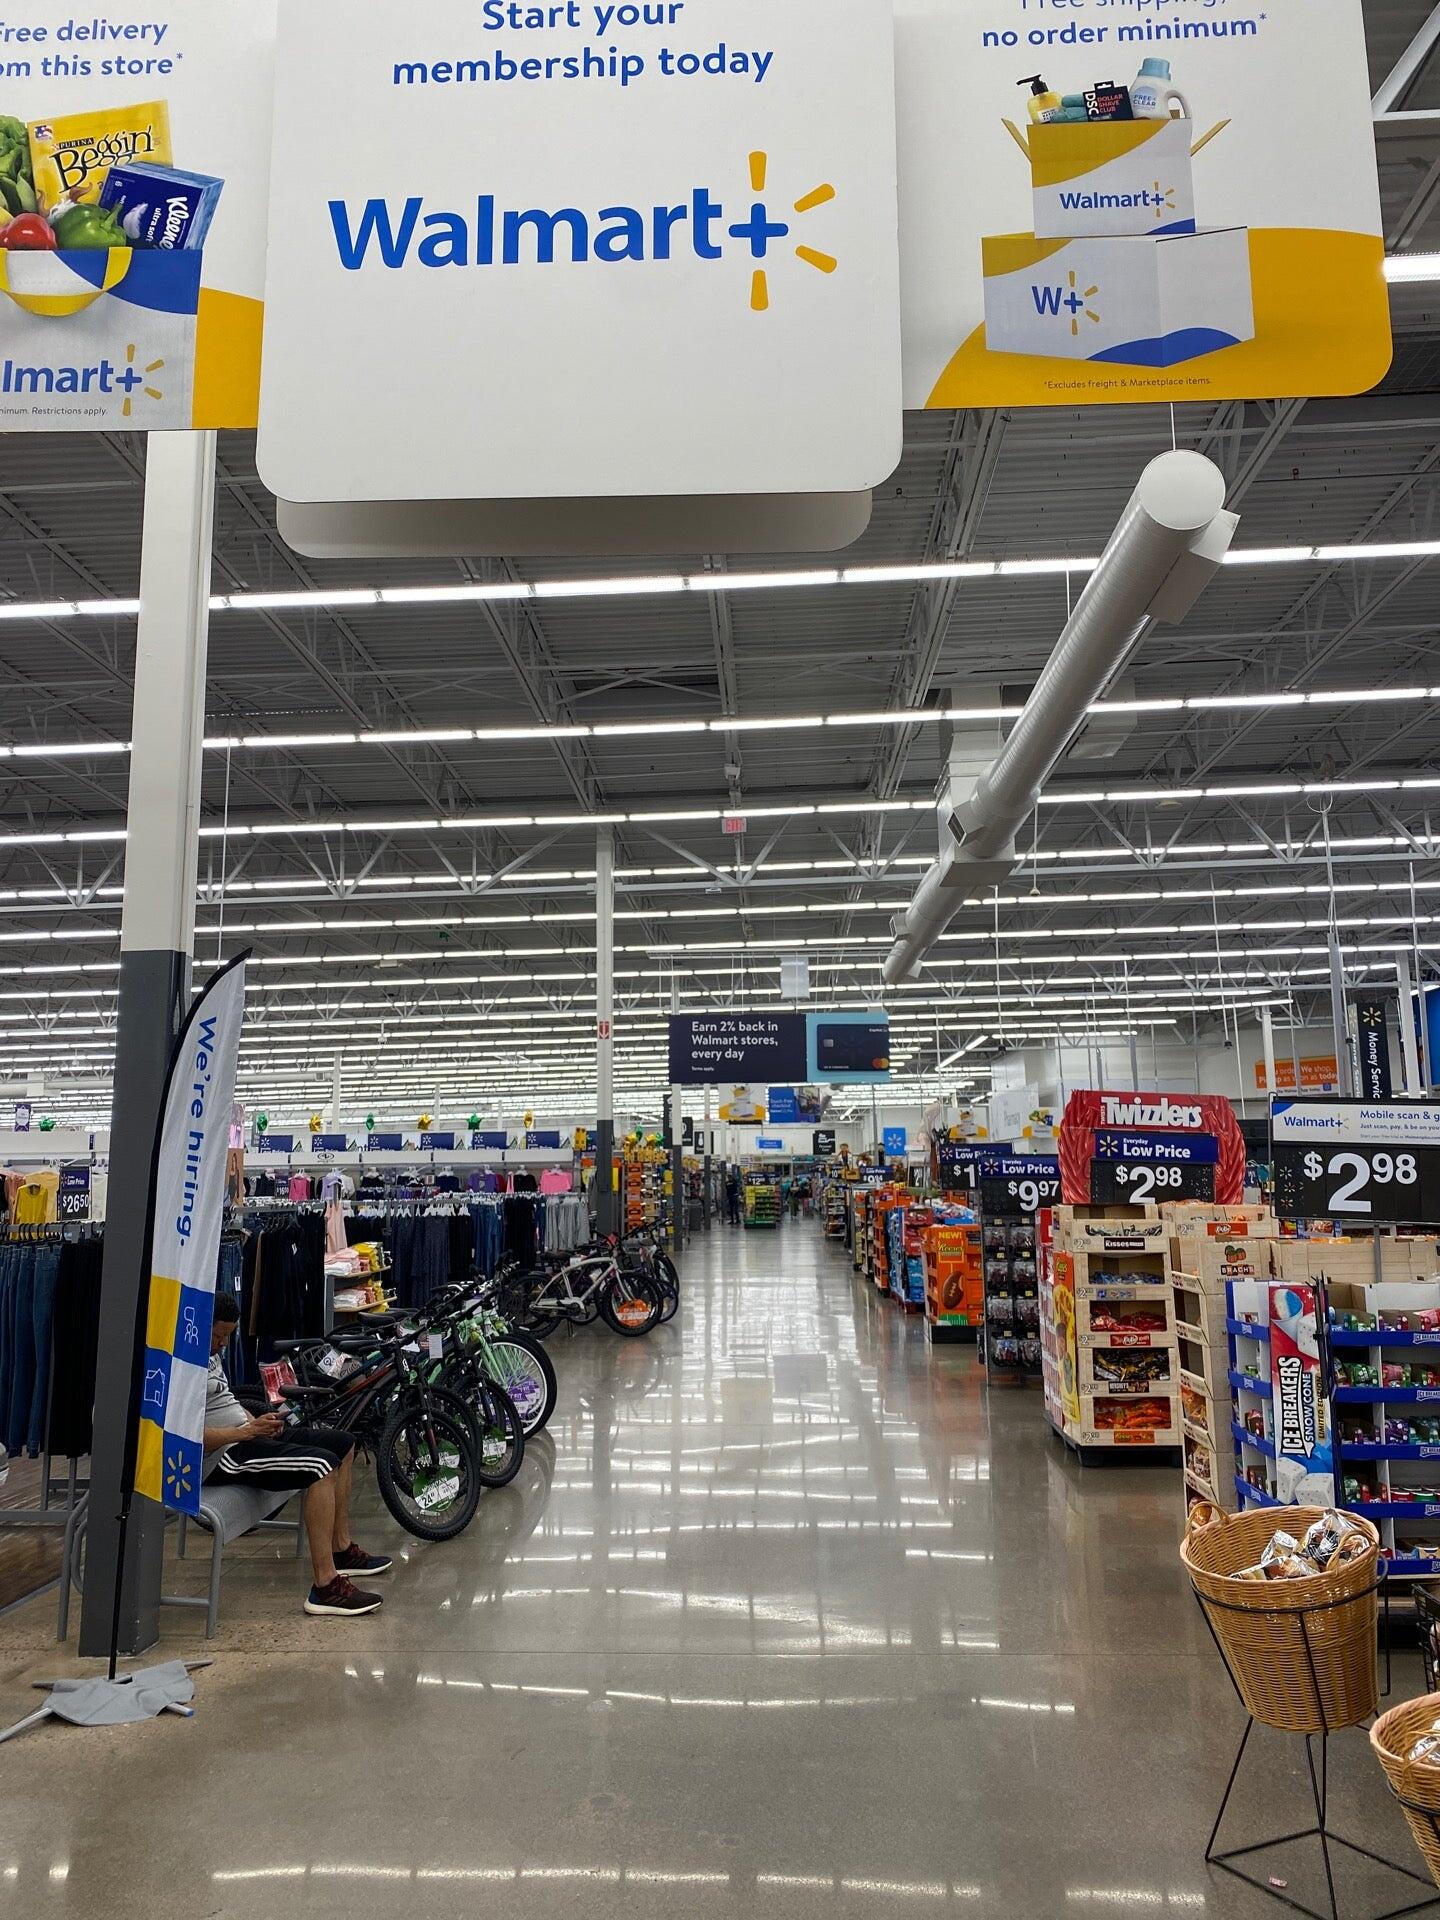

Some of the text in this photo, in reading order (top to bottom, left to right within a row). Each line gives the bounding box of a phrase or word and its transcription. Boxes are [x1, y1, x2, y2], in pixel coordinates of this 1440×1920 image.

[483, 0, 684, 36] Start your
[56, 19, 168, 46] delivery
[982, 26, 1018, 46] no
[1028, 22, 1108, 45] order
[41, 54, 91, 77] this
[394, 43, 773, 86] membership today
[1085, 92, 1099, 115] DSC
[1097, 94, 1123, 102] DOLLAR
[60, 138, 94, 149] PURINA
[146, 207, 162, 242] ultra soft
[328, 188, 789, 270] Walmart+
[1088, 379, 1118, 389] freight
[1129, 377, 1184, 388] Marketplace
[31, 406, 82, 415] Restrictions
[83, 407, 108, 419] apply.
[692, 1021, 778, 1032] Earn 2% back in
[691, 1034, 779, 1047] Walmart stores,
[691, 1048, 744, 1062] every day
[1367, 1031, 1383, 1099] Money Servic
[1101, 1096, 1203, 1128] Twizzlers
[1360, 1110, 1394, 1119] Mobile
[1423, 1111, 1430, 1119] &
[177, 1017, 217, 1247] We're hiring.
[956, 1151, 974, 1159] Low
[1123, 1145, 1191, 1158] Low Price
[1002, 1164, 1055, 1174] Low Price
[938, 1231, 962, 1239] NEW!
[1279, 1356, 1305, 1454] ICE BREAKERS
[1302, 1373, 1314, 1441] SNOW CONE
